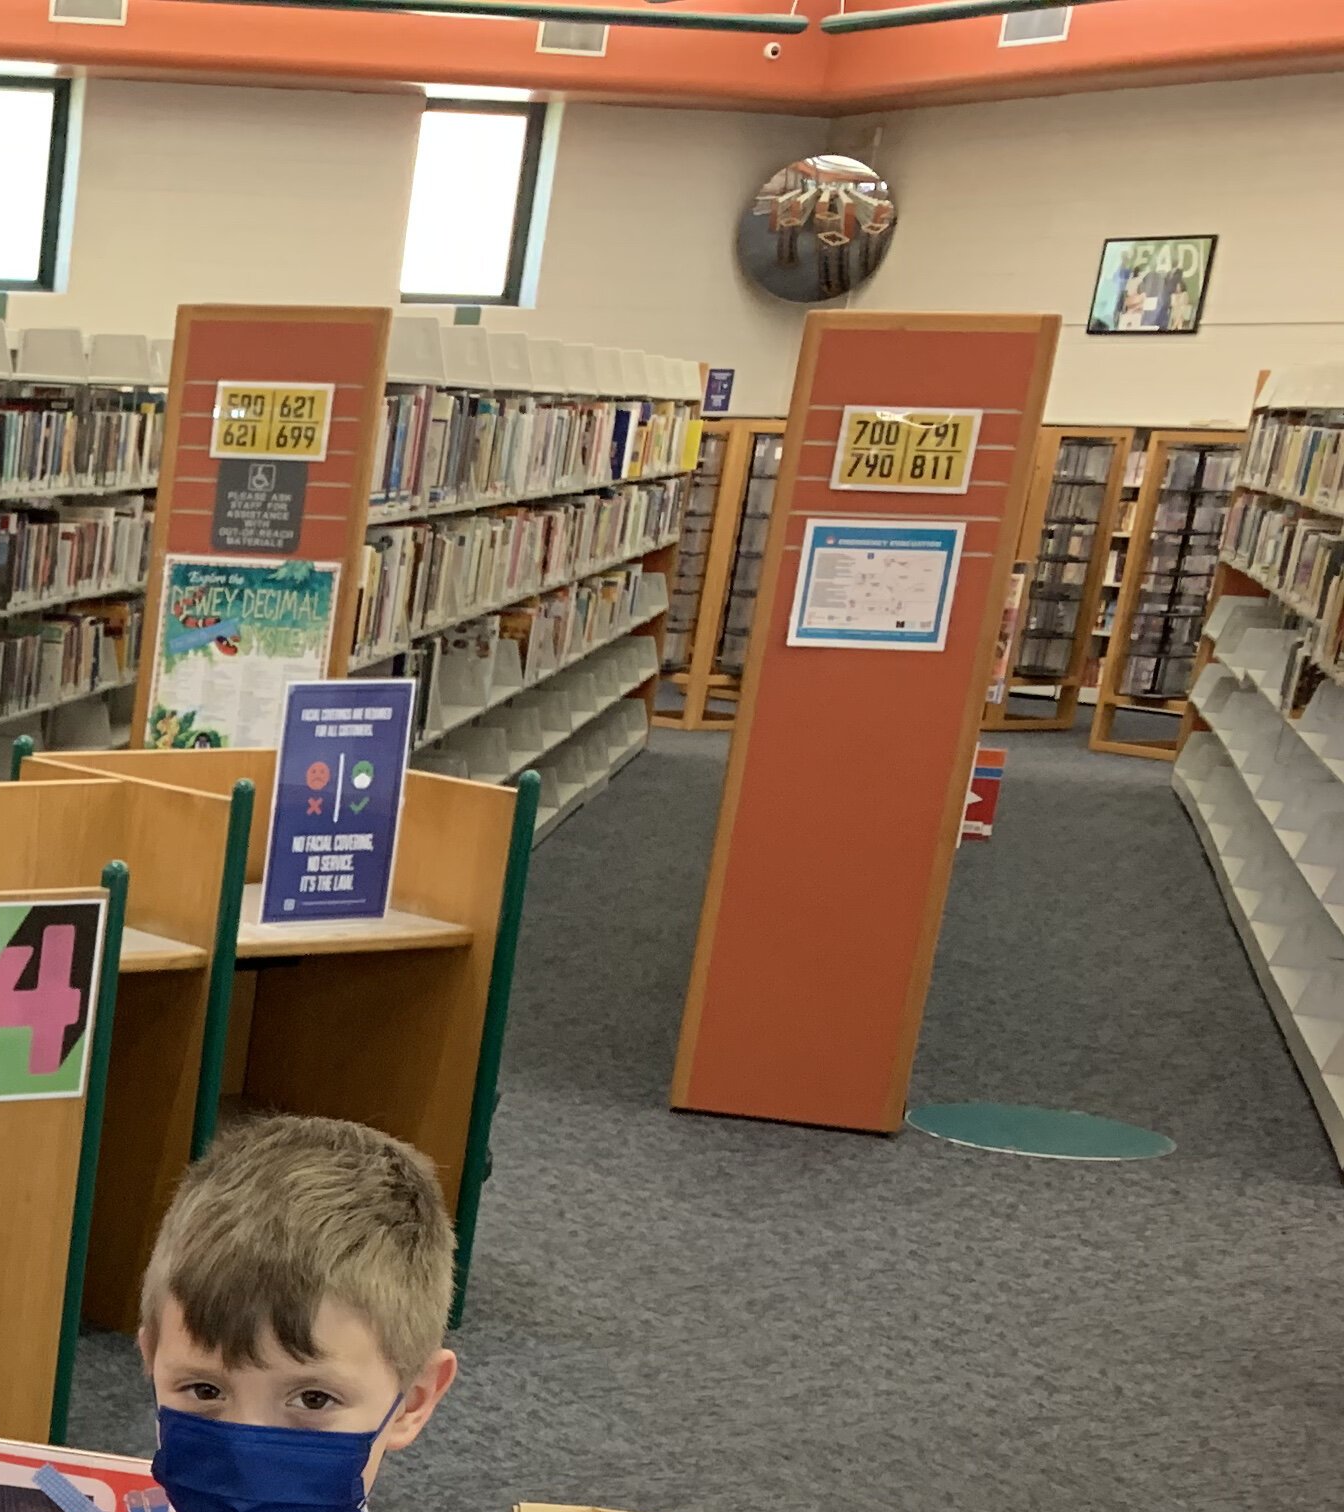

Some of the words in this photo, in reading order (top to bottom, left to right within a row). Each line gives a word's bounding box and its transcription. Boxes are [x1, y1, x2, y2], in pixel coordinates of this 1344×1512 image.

[279, 395, 315, 419] 621
[223, 424, 256, 447] 621
[276, 425, 316, 449] 699
[853, 420, 900, 446] 700
[916, 422, 960, 448] 791
[847, 453, 895, 478] 790
[910, 455, 954, 480] 811
[227, 491, 266, 501] PLEASE
[271, 493, 292, 502] ASK
[227, 510, 290, 520] ASSISTANCE
[230, 501, 262, 510] STAFF
[267, 502, 288, 511] FOR
[244, 520, 270, 528] WITH
[226, 537, 284, 548] MATERIALS
[188, 571, 227, 585] Explore
[228, 573, 245, 584] the
[171, 585, 240, 617] DEWEY
[241, 588, 322, 620] DECIMAL
[301, 708, 320, 721] FACIAL
[326, 724, 338, 737] ALL
[292, 836, 306, 853] NO
[306, 835, 332, 852] FACIAL
[307, 856, 320, 872] NO
[320, 854, 354, 872] SERVICE.
[299, 876, 317, 892] IT'S
[317, 875, 333, 892] THE
